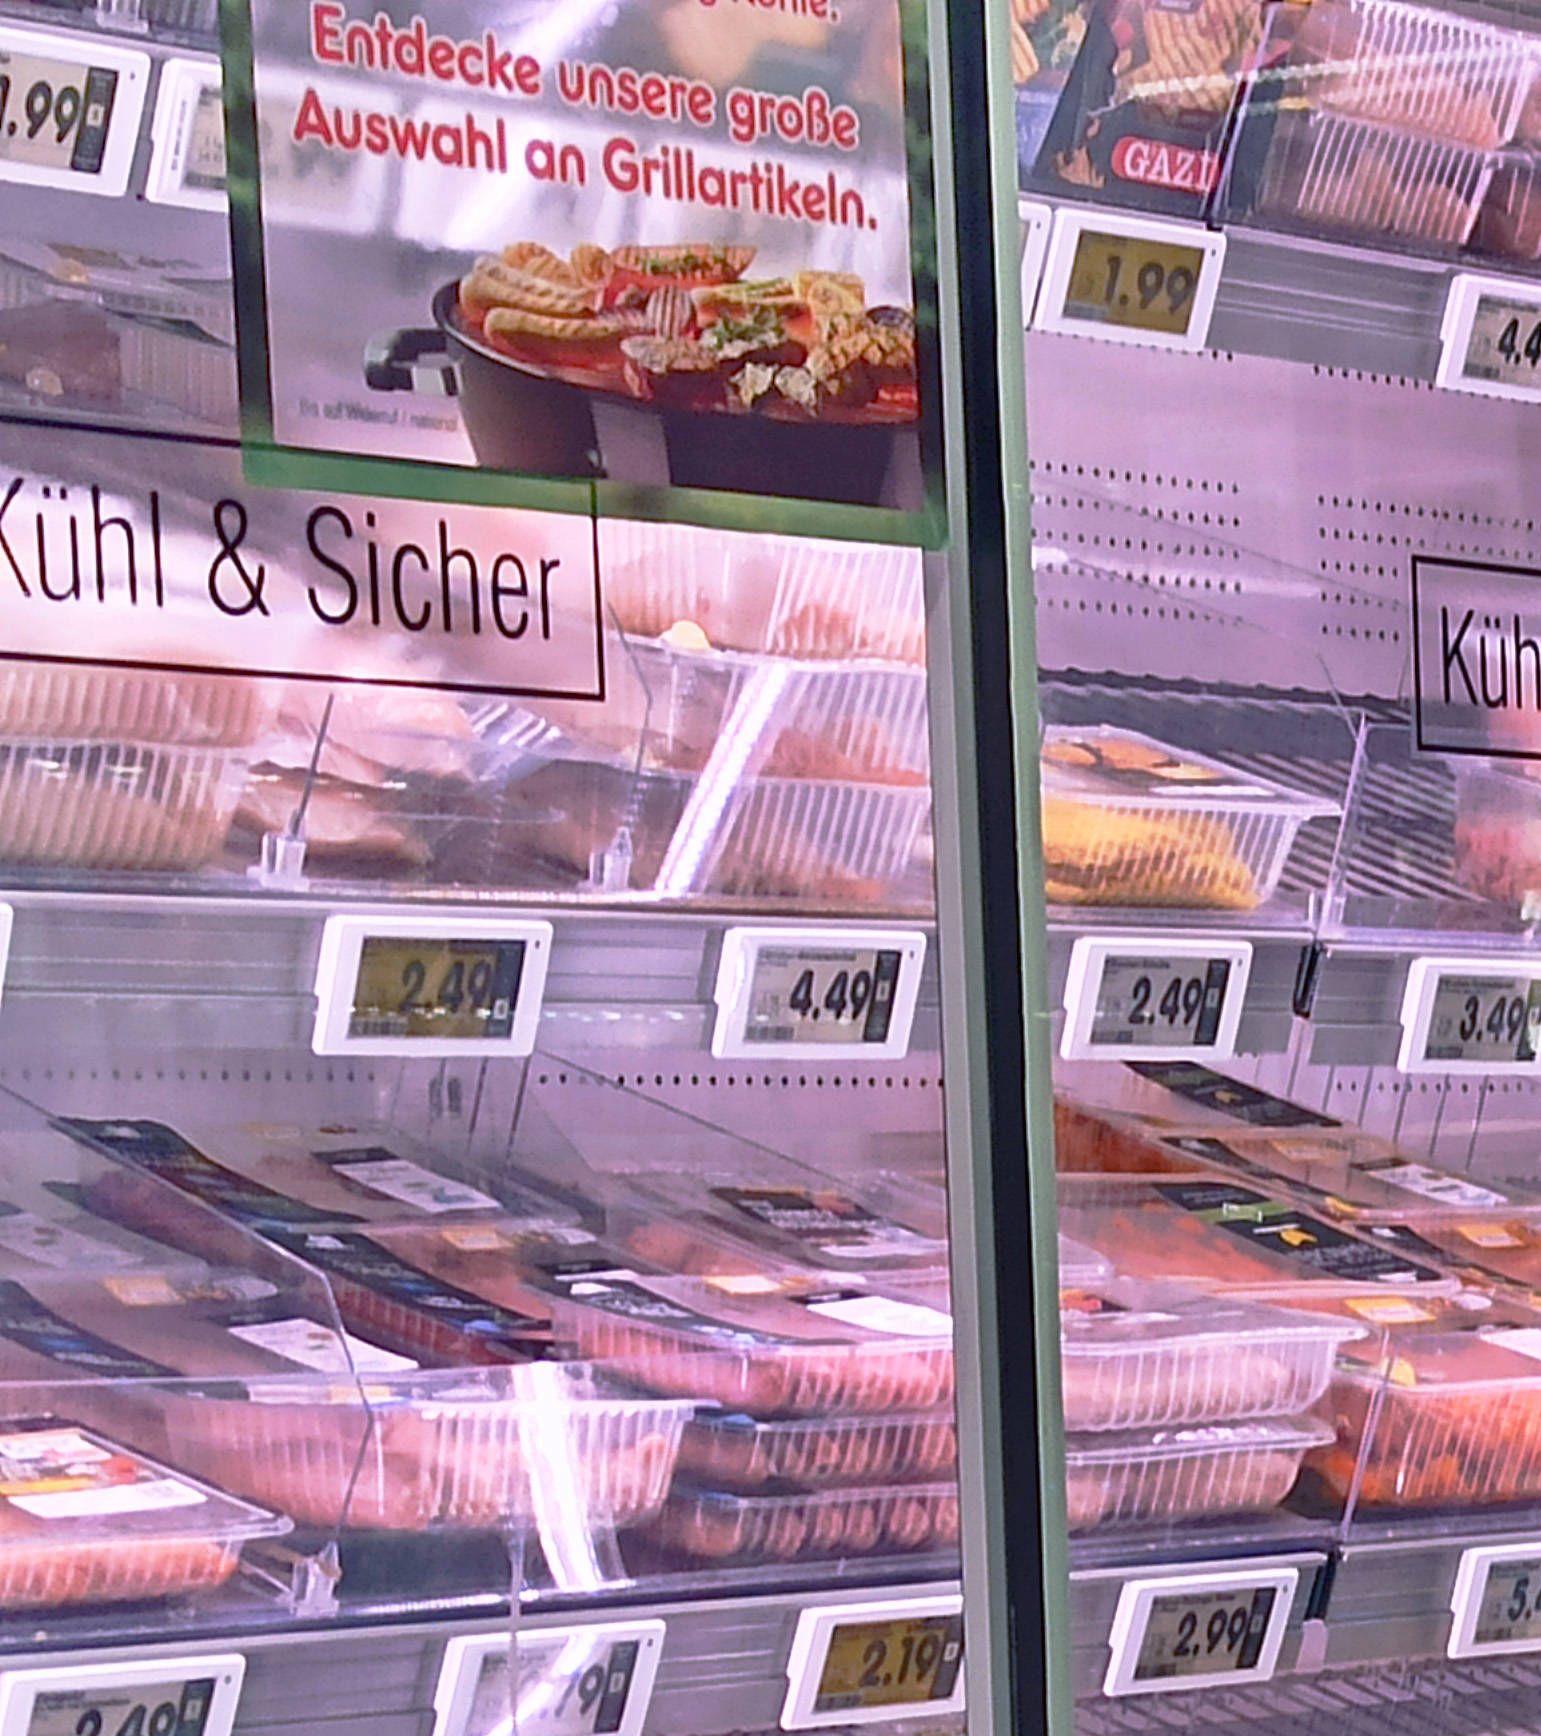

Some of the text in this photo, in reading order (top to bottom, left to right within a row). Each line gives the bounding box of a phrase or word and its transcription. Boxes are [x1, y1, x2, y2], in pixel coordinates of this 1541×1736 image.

[313, 3, 858, 148] Entdecke unsere große
[293, 87, 878, 230] Auswahl an Grillartikeln.
[1104, 255, 1194, 315] 1.99
[208, 499, 270, 617] &
[305, 505, 561, 640] Sicher
[789, 969, 872, 1021] 4.49
[1128, 976, 1202, 1025] 2.49
[1459, 995, 1525, 1043] 3.49
[859, 1631, 941, 1689] 2.19
[1173, 1605, 1247, 1658] 2.99
